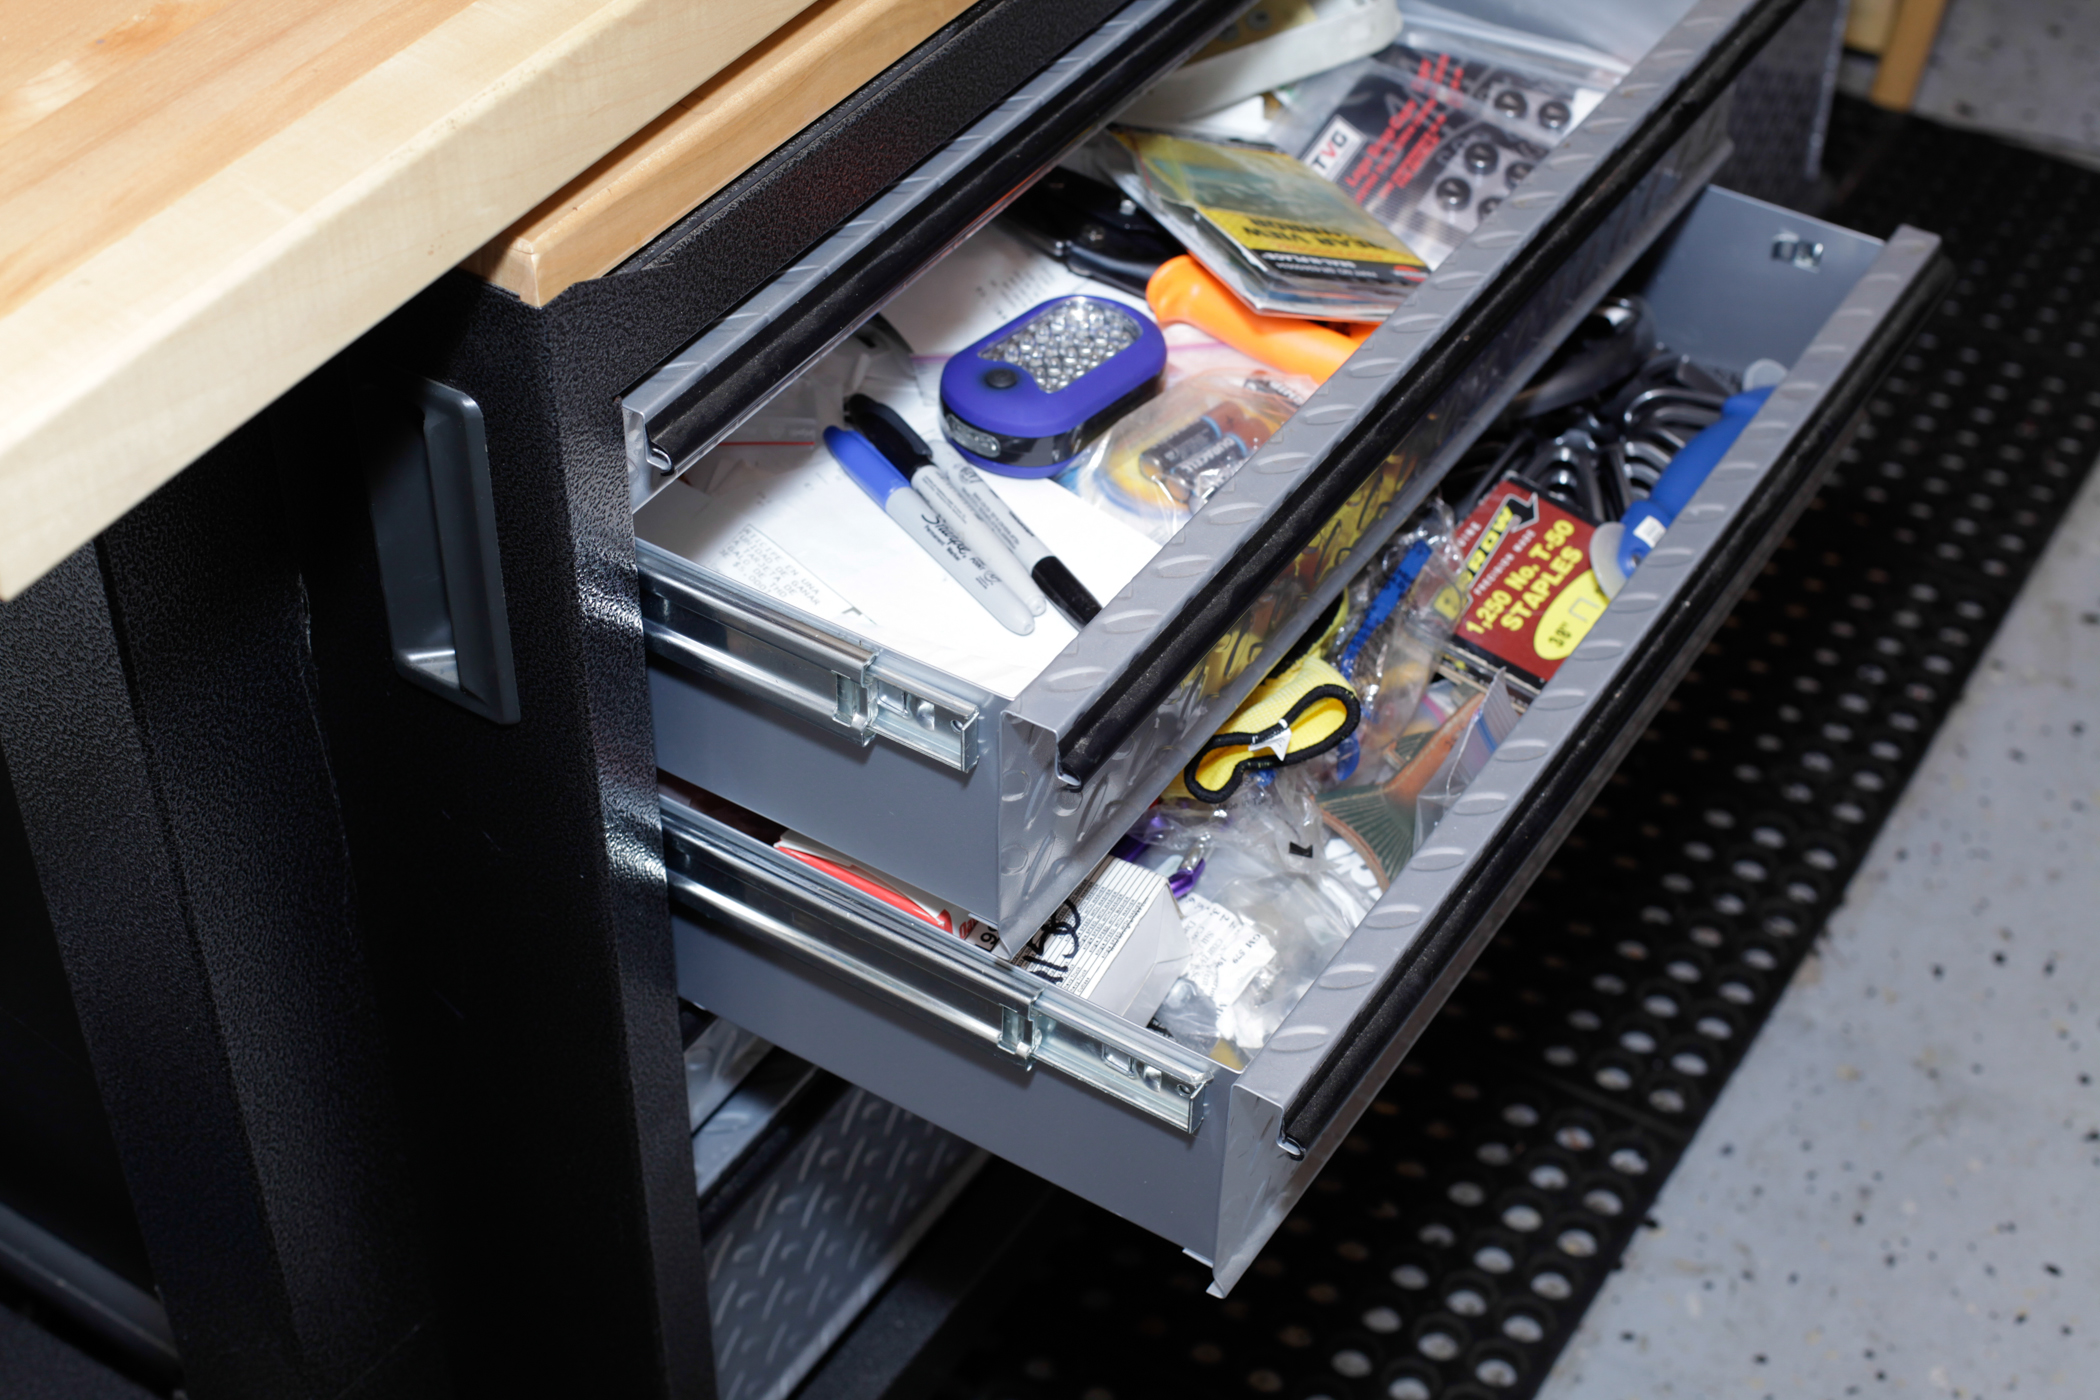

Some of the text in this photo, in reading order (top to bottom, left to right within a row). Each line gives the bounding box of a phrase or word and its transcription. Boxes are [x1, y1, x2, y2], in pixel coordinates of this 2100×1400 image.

[1312, 131, 1346, 170] TVG
[801, 578, 818, 594] UNA
[1465, 588, 1512, 634] 1,250
[1504, 564, 1539, 588] No.
[1500, 546, 1583, 631] STAPLES
[1245, 933, 1260, 947] GM
